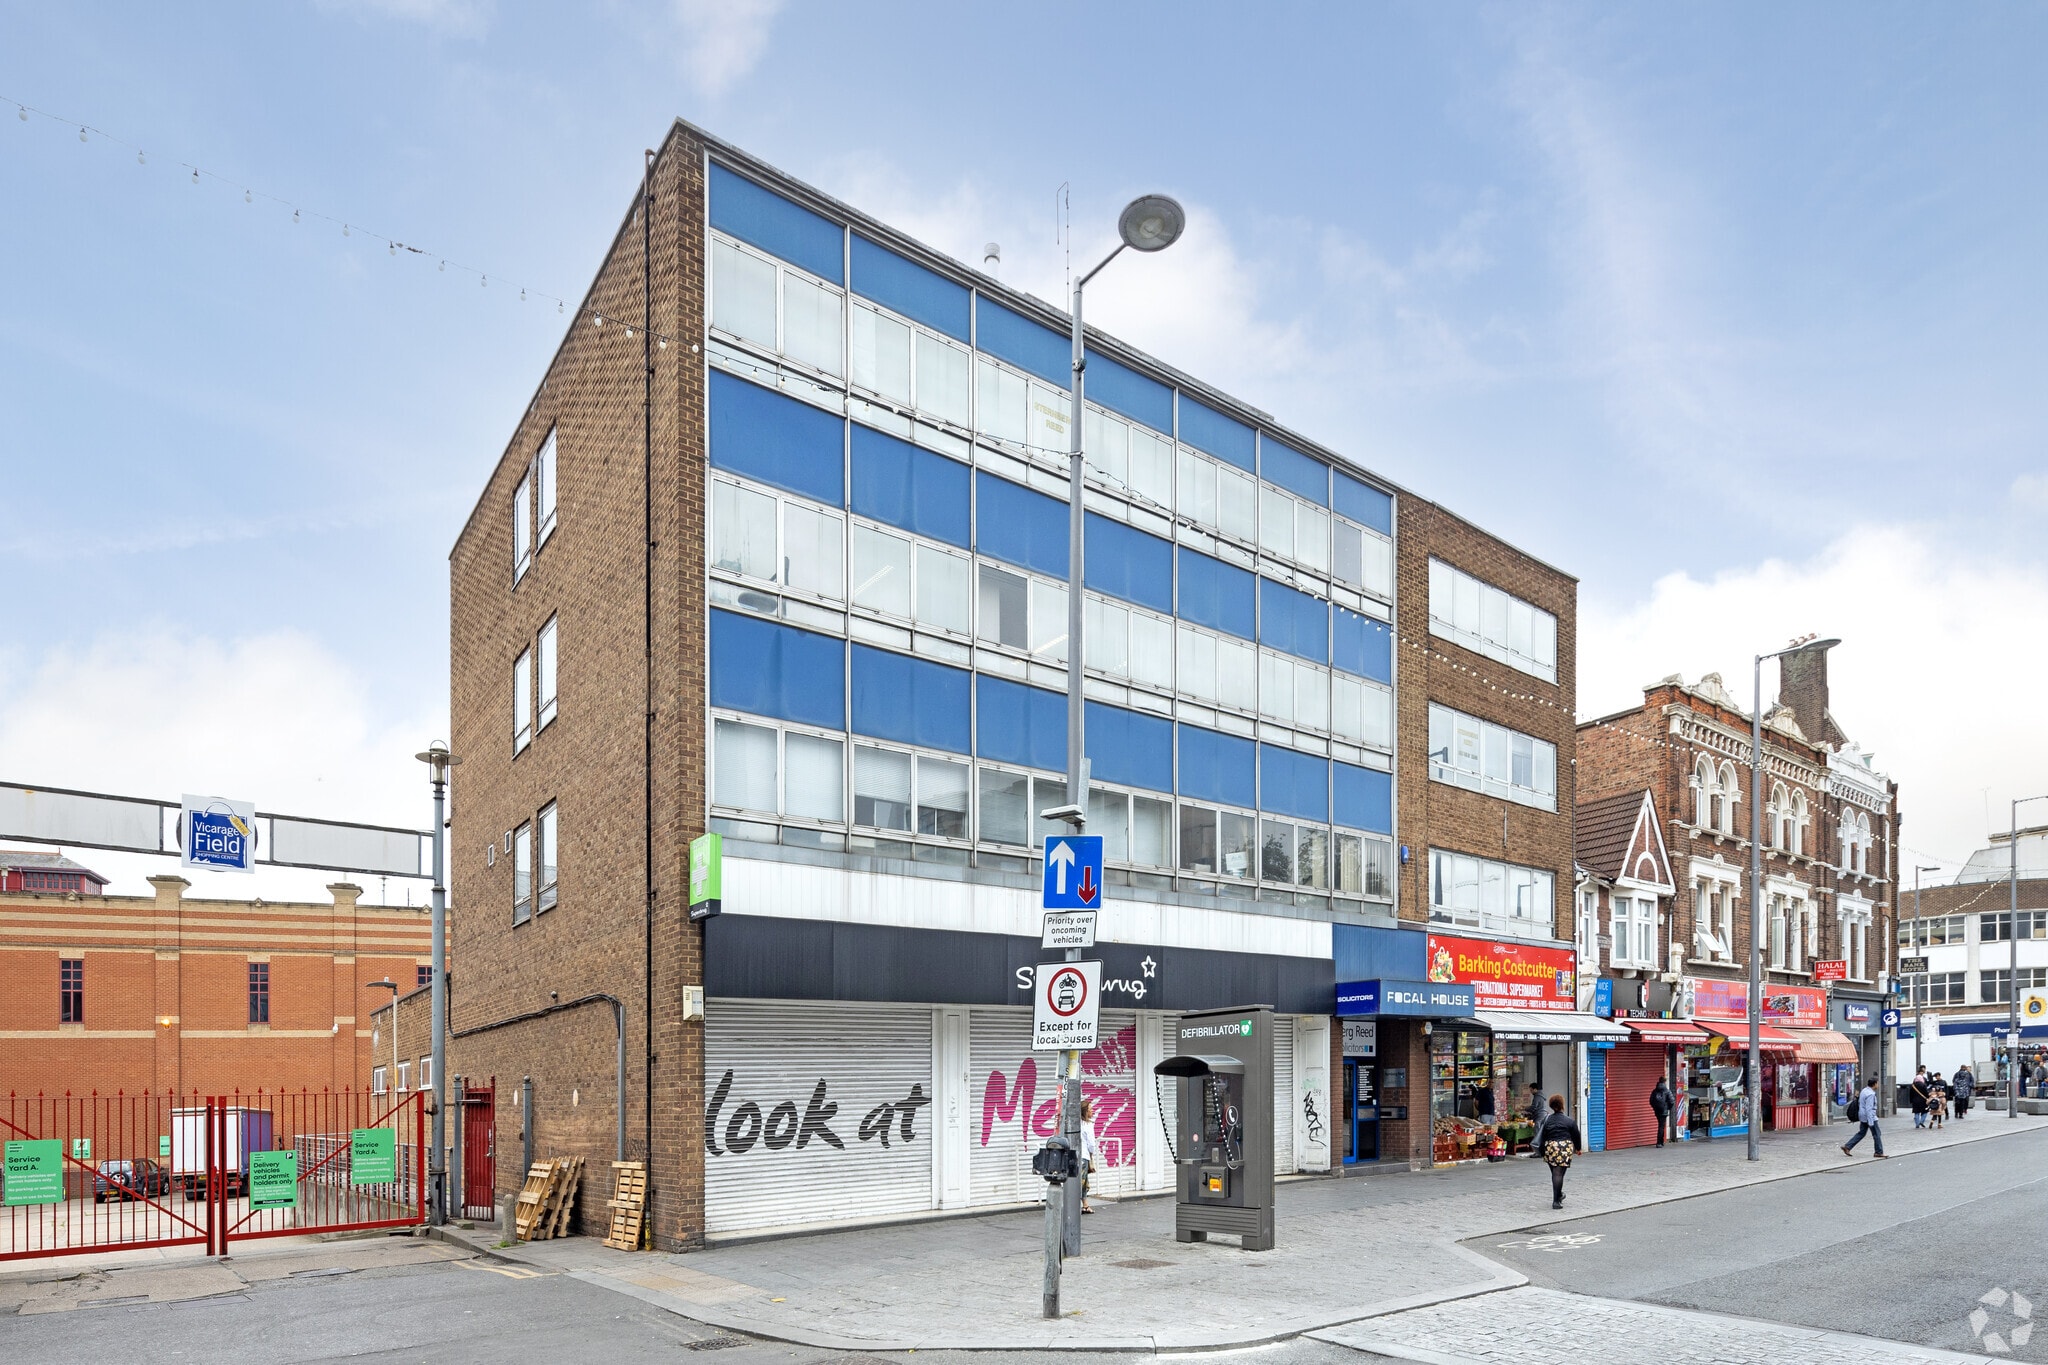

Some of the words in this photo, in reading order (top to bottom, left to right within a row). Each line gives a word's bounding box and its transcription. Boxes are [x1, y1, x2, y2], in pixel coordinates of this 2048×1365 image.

[1034, 401, 1072, 425] STERNBER
[195, 821, 240, 837] Vicarage
[195, 832, 240, 853] Field
[1047, 917, 1075, 925] Priority
[1077, 916, 1093, 924] over
[1051, 926, 1087, 935] oncoming
[1458, 953, 1501, 979] Barking
[1503, 958, 1557, 979] Costcutter
[1509, 983, 1543, 997] SUPERMARKET
[1337, 994, 1374, 1003] SOLICITORS
[1387, 991, 1427, 1004] FOCAL
[1431, 993, 1469, 1006] HOUSE
[1596, 1006, 1609, 1015] CARE
[1630, 1009, 1647, 1018] TECHNO
[1040, 1021, 1074, 1032] Except
[1077, 1020, 1092, 1030] for
[1181, 1024, 1241, 1039] DEFIBRILLATOR
[1355, 1025, 1374, 1038] Reed
[1036, 1034, 1060, 1044] local
[1342, 1042, 1364, 1052] licitors
[857, 1082, 933, 1150] at
[8, 1156, 41, 1164] Service
[268, 1173, 290, 1181] permit
